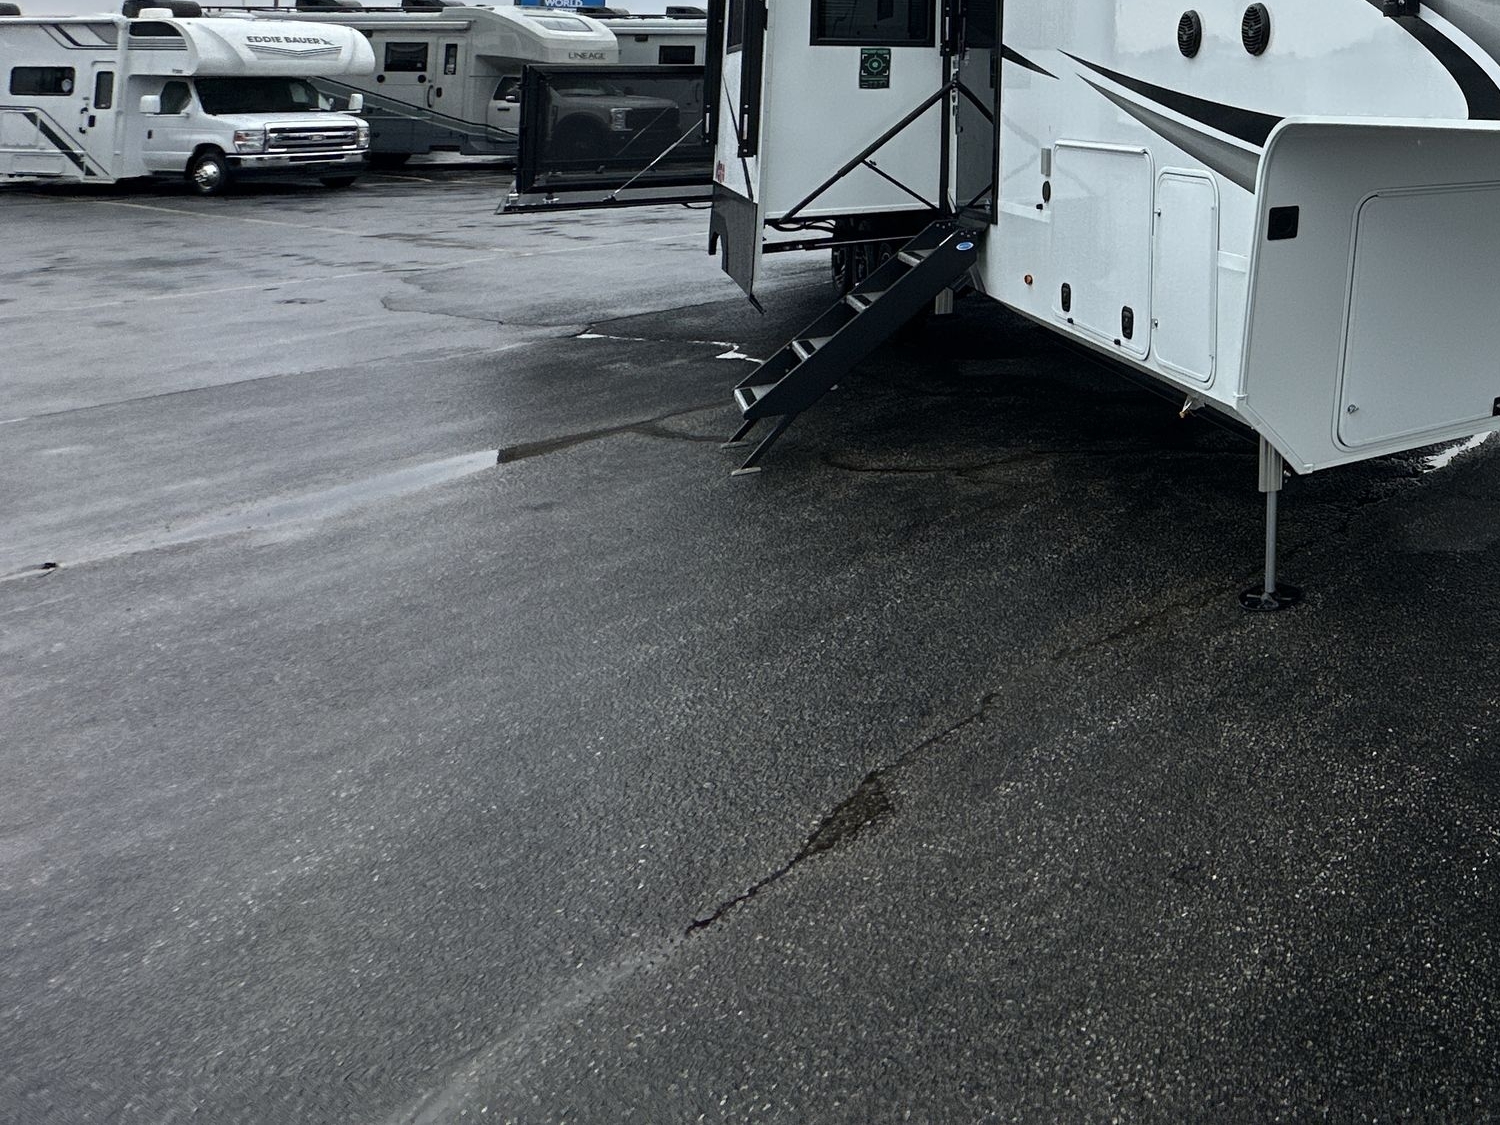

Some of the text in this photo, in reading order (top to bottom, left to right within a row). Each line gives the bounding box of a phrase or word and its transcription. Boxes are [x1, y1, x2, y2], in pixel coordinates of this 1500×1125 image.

[544, 0, 583, 7] WORLD
[284, 36, 320, 44] BAUER
[568, 52, 606, 60] LINEAGE
